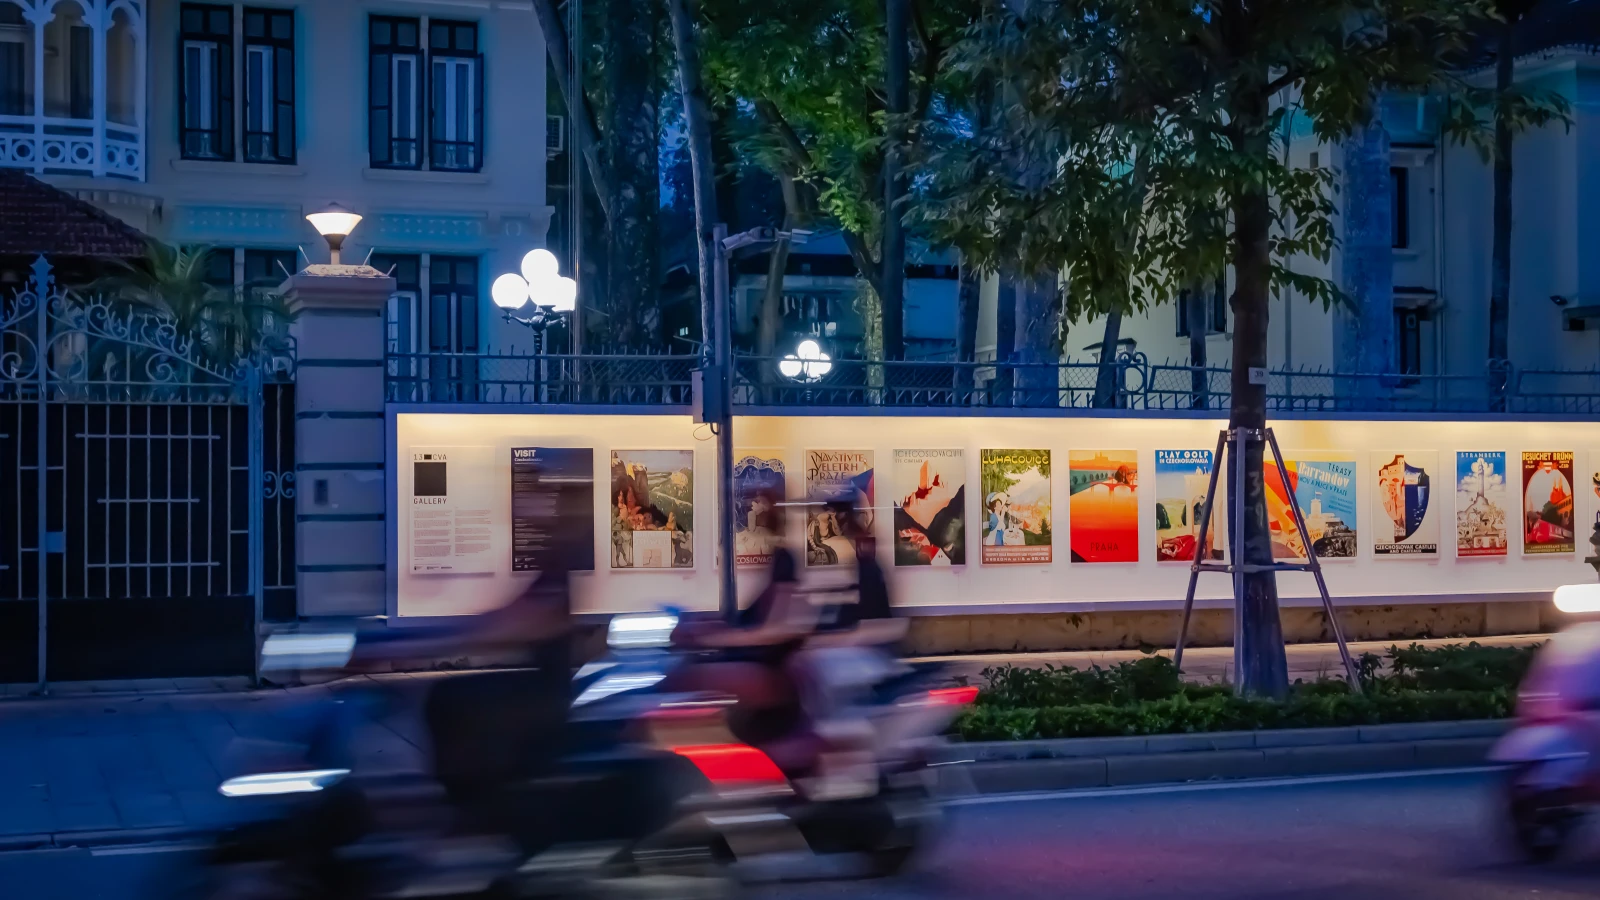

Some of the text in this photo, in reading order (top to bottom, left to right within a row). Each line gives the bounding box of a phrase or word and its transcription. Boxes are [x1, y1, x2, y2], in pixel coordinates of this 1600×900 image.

[514, 450, 537, 458] VISIT
[1159, 451, 1209, 459] PLAY GOLF
[1298, 461, 1351, 488] Barrandov
[1328, 462, 1353, 477] TERASY
[1090, 542, 1120, 552] PRAHA
